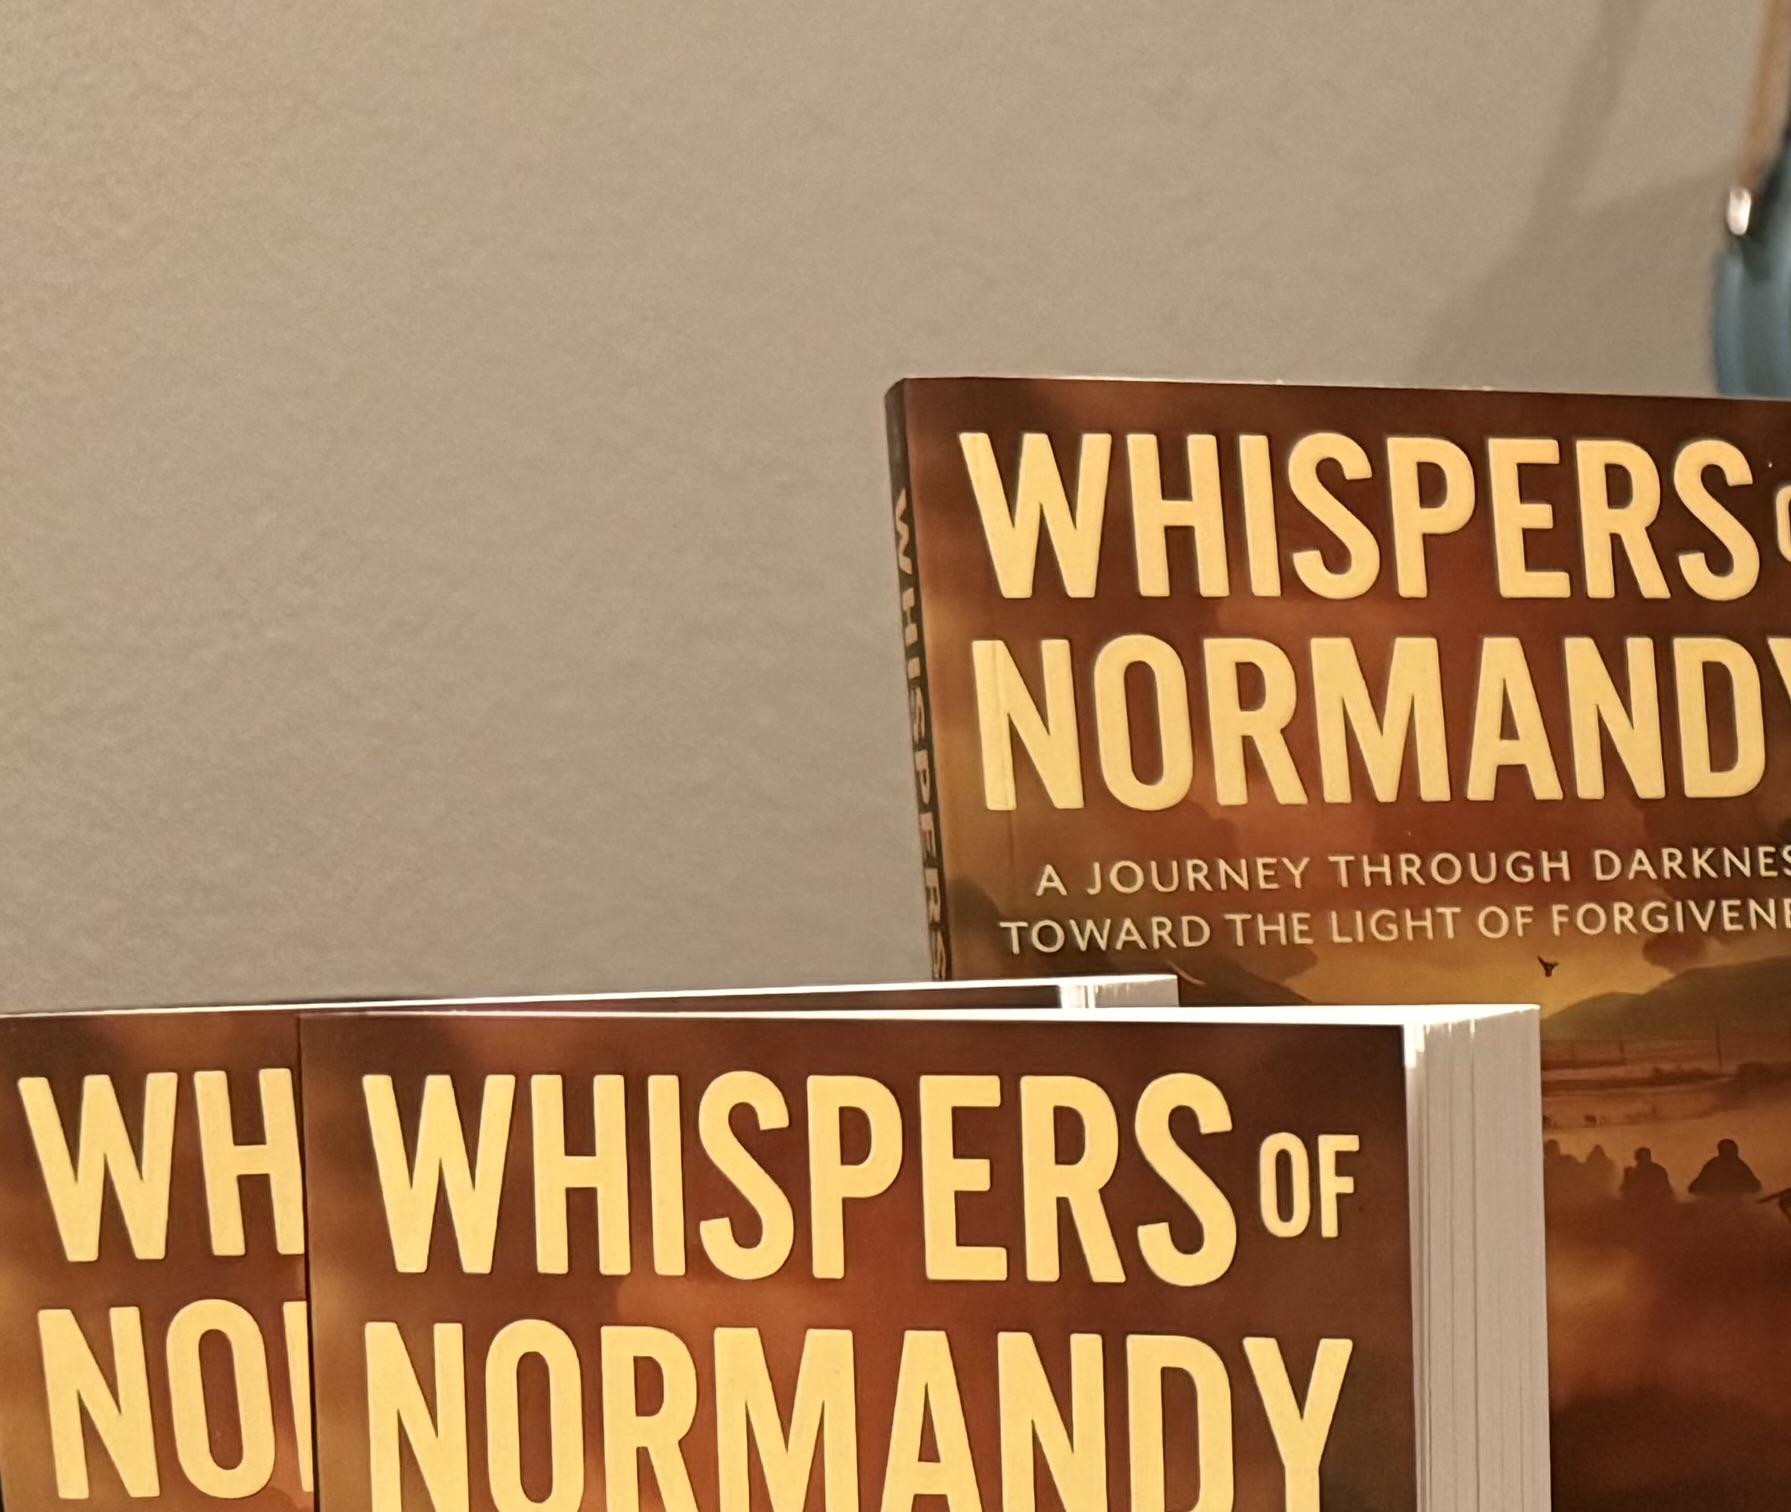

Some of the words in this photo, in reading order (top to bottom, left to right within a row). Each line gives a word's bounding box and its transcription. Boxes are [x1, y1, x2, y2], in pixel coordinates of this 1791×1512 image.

[958, 431, 1760, 601] WHISPERS
[1036, 864, 1068, 897] A
[1086, 856, 1310, 895] JOURNEY
[1327, 850, 1571, 888] THROUGH
[999, 915, 1211, 954] TOWARD
[1223, 912, 1314, 947] THE
[1330, 906, 1462, 943] LIGHT
[1477, 905, 1534, 939] OF
[362, 1070, 1237, 1287] WHISPERS
[1259, 1131, 1360, 1238] OF
